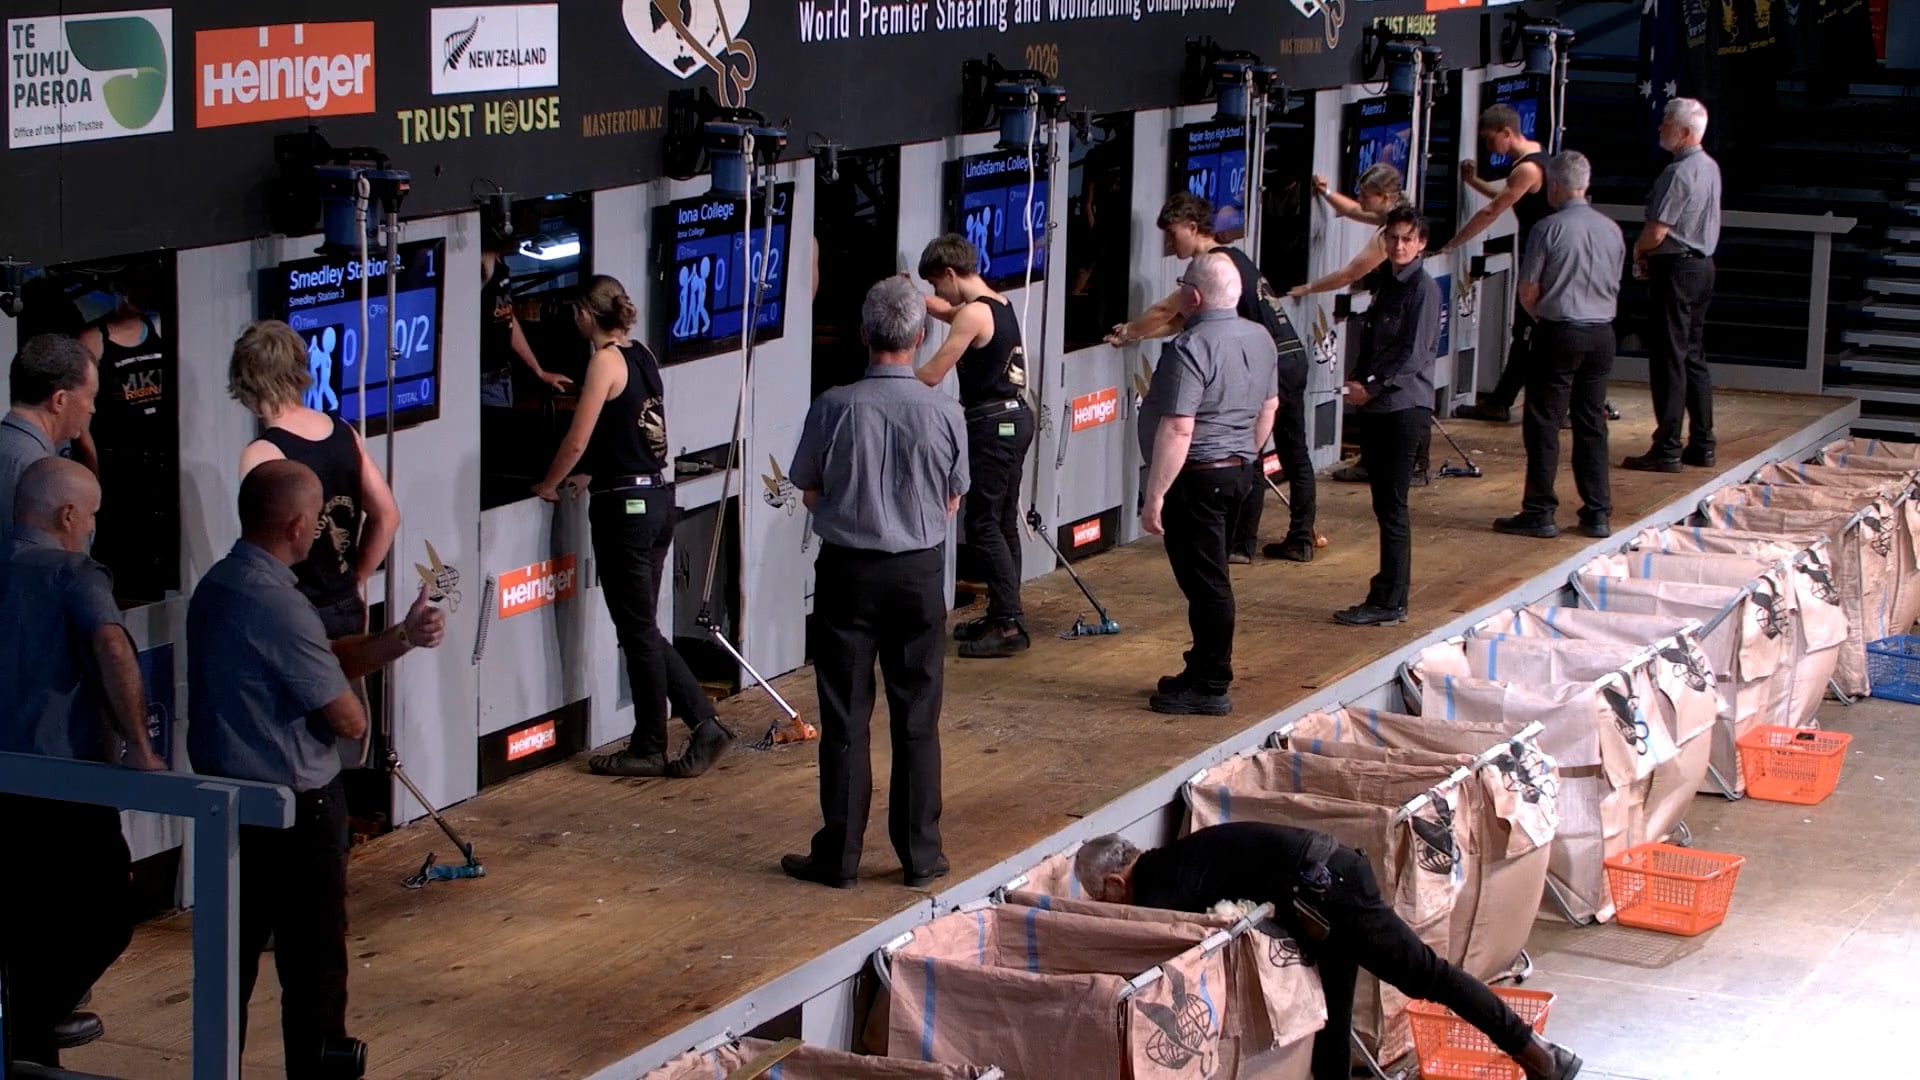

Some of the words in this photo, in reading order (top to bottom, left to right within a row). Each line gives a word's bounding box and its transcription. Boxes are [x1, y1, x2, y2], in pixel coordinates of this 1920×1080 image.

[799, 0, 850, 43] World
[859, 0, 928, 38] Premier
[936, 0, 1008, 33] Shearing
[1014, 0, 1041, 24] and
[1407, 14, 1436, 35] HOUSE
[12, 24, 36, 49] TE
[13, 50, 70, 78] TUMU
[203, 23, 371, 110] Heiniger
[469, 51, 494, 69] NEW
[496, 47, 547, 67] ZEALAND
[1026, 43, 1059, 79] 2026
[14, 77, 93, 109] PAEROA
[13, 127, 34, 138] Office
[35, 125, 42, 136] of
[43, 124, 55, 135] the
[78, 120, 105, 132] Trustee
[396, 104, 475, 145] TRUST
[484, 96, 561, 136] HOUSE
[582, 105, 664, 138] MASTERTON.NZ
[1007, 155, 1029, 172] Colleg
[678, 207, 699, 224] Iona
[700, 201, 735, 220] College
[290, 263, 344, 291] Smedley
[426, 249, 436, 278] 1
[751, 248, 779, 283] 02
[289, 293, 317, 307] Smedley
[317, 290, 339, 301] Station
[340, 289, 345, 298] 3
[343, 328, 357, 367] 0
[395, 315, 430, 359] 0/2
[420, 378, 430, 400] 0
[1074, 391, 1117, 424] Heiniger
[502, 561, 576, 609] Heiniger
[510, 727, 555, 754] Heiniger
